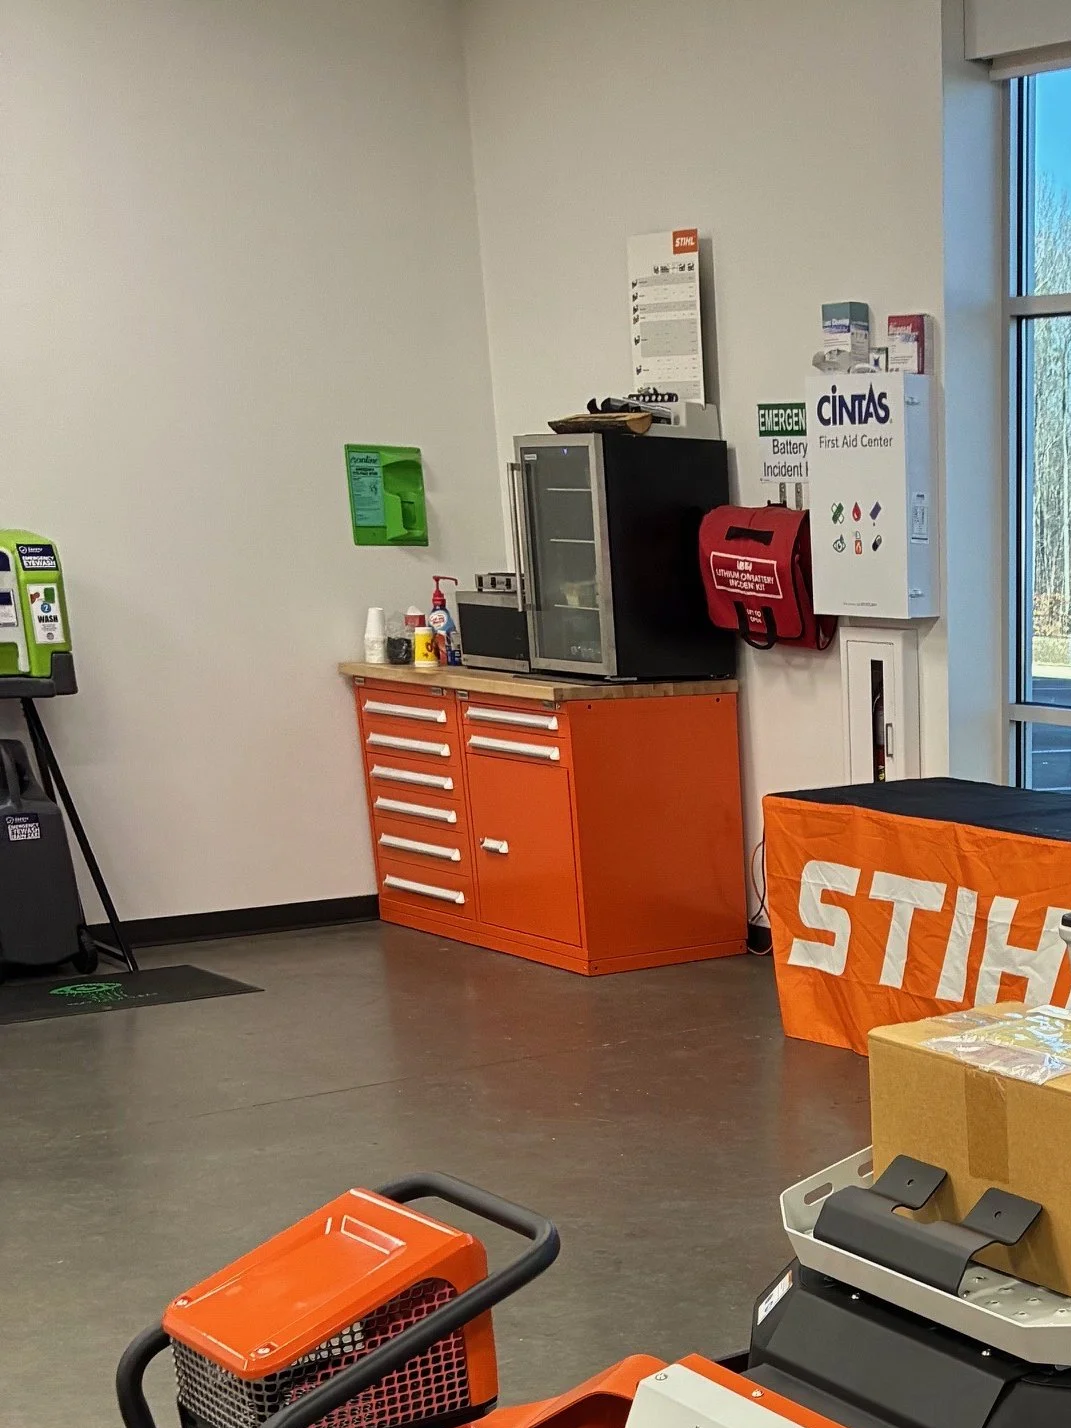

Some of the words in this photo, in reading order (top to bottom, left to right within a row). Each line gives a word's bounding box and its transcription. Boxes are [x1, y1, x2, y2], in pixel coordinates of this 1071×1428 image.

[675, 236, 695, 247] STIHL
[819, 436, 839, 448] First
[841, 434, 858, 448] Aid
[860, 434, 893, 448] Center
[772, 439, 808, 458] Battery
[763, 461, 803, 477] Incident
[38, 615, 58, 623] WASH
